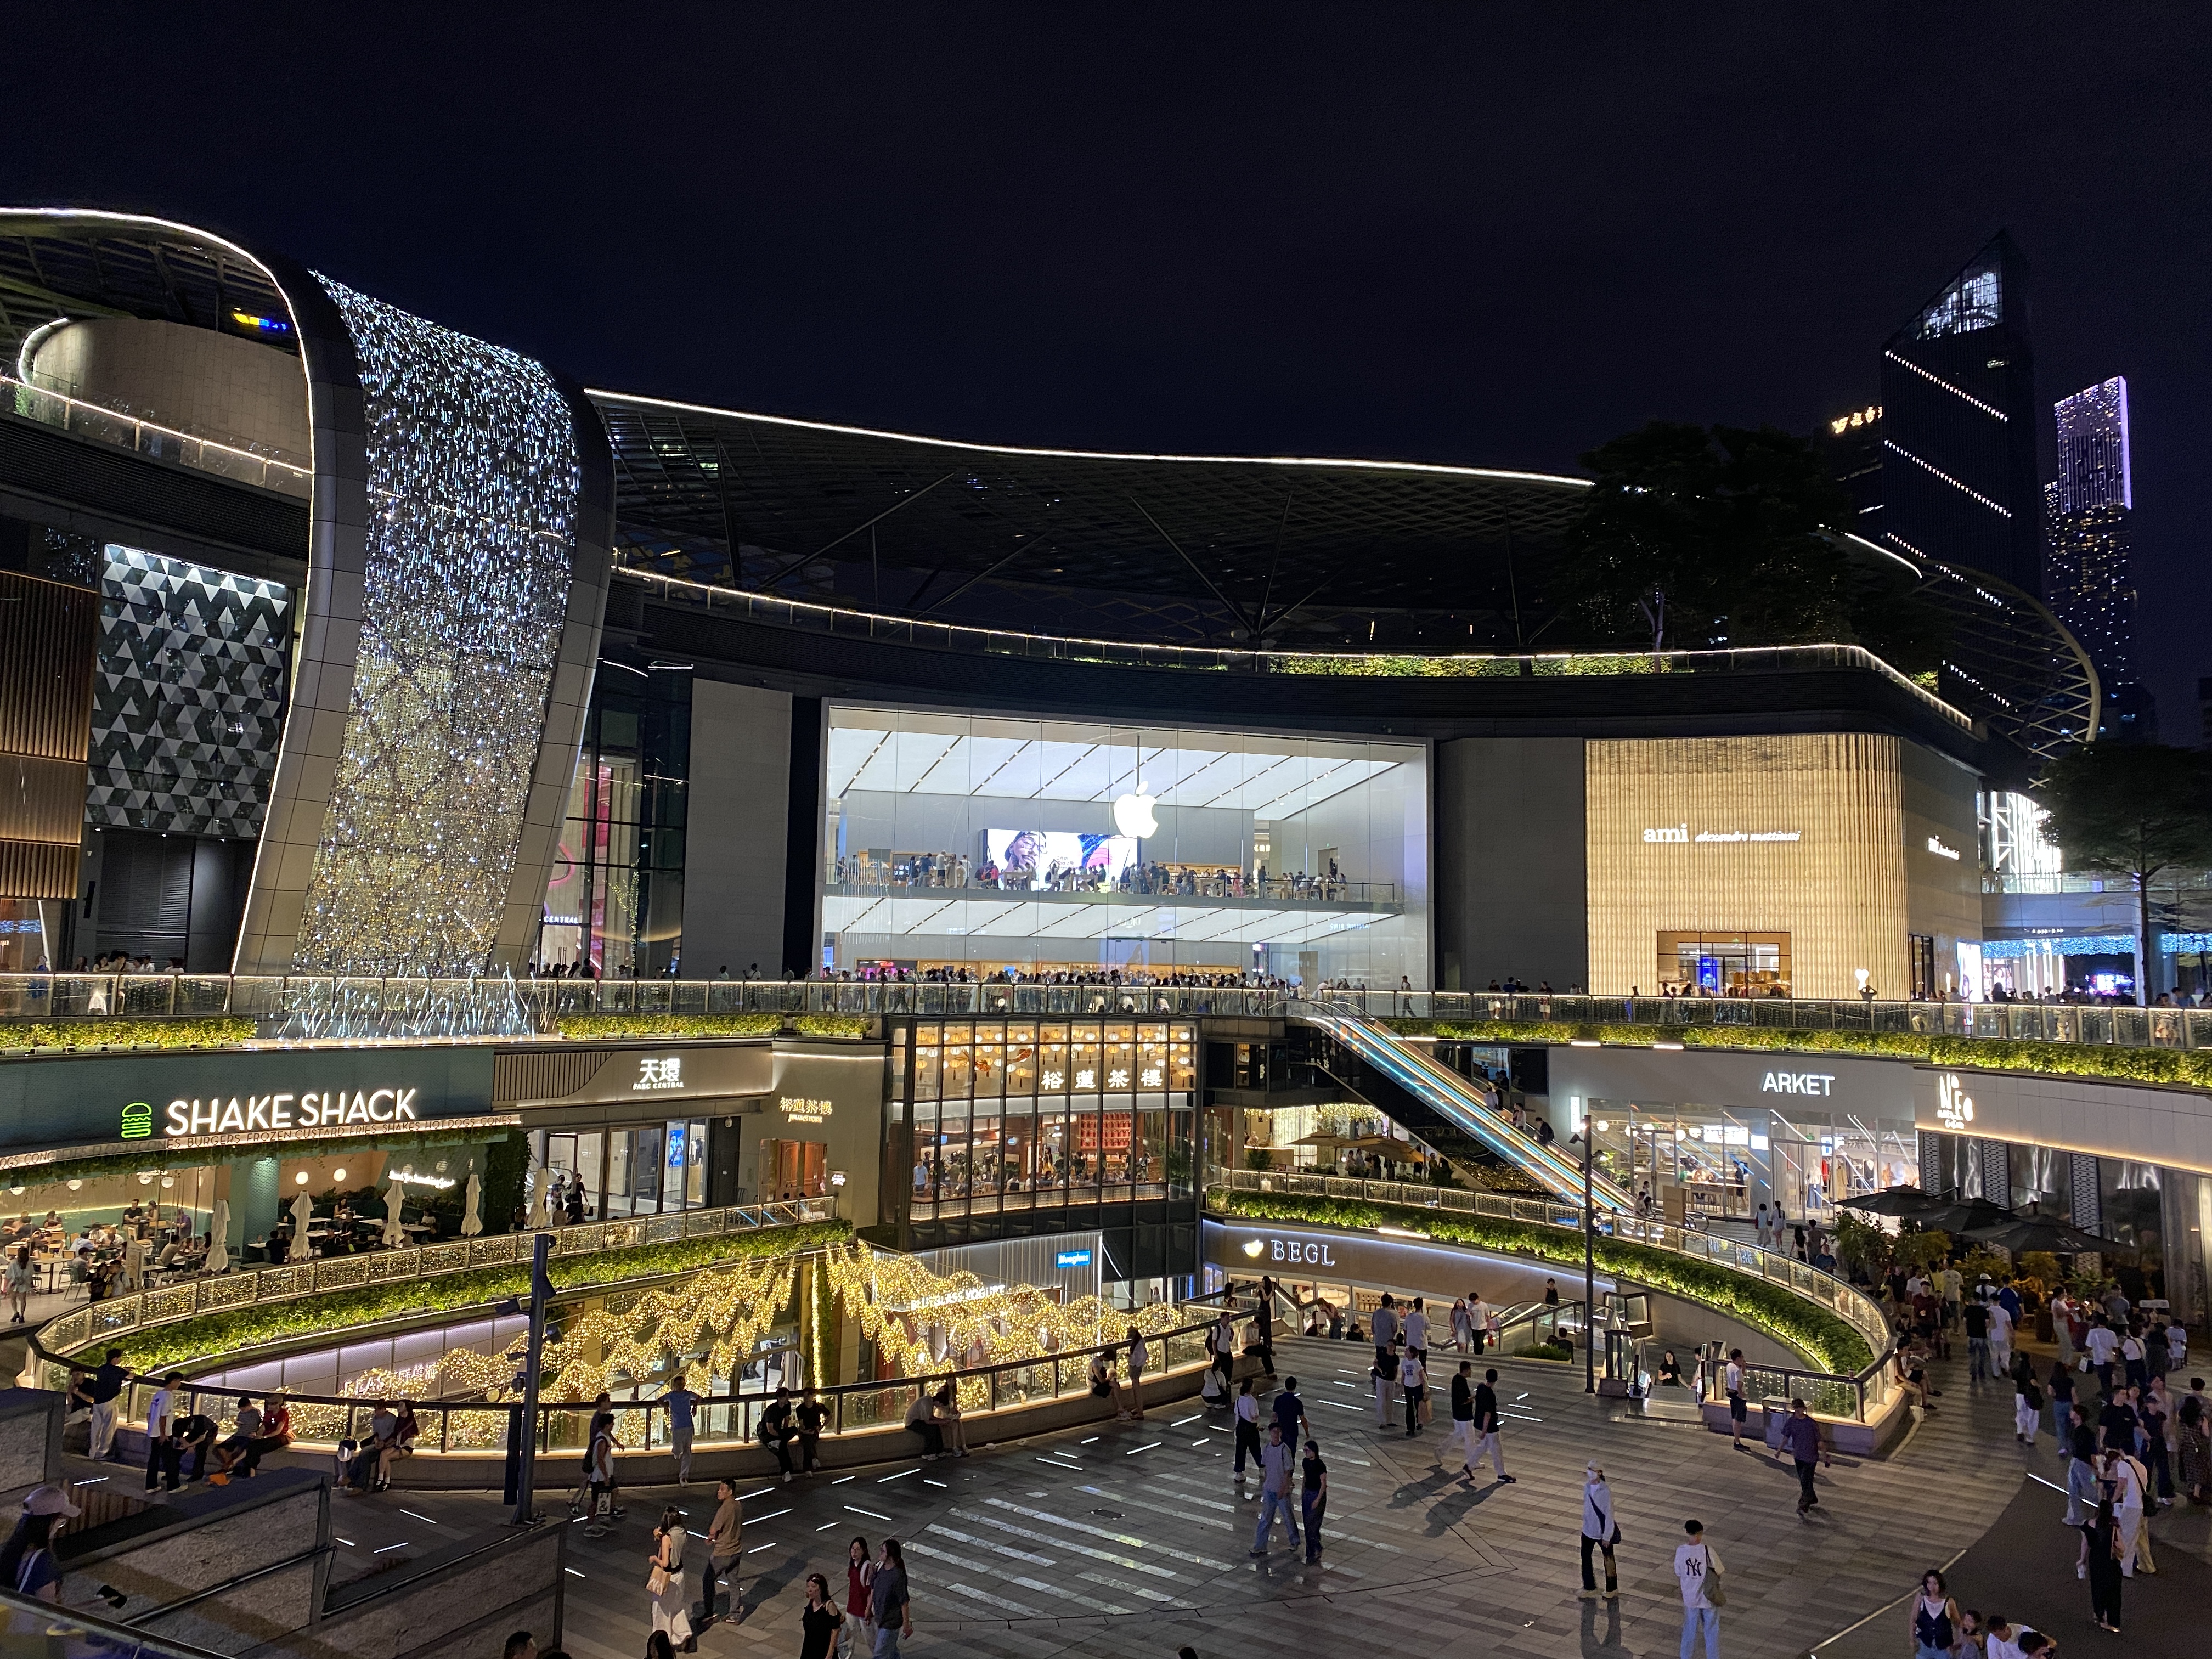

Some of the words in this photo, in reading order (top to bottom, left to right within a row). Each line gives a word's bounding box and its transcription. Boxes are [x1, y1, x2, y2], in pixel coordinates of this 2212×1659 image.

[1644, 823, 1689, 842] ami
[640, 1058, 680, 1084] 天環
[653, 1081, 684, 1089] CENTRAL
[1762, 1072, 1836, 1096] ARKET
[165, 1095, 294, 1136] SHAKE
[298, 1088, 416, 1127] SHACK
[187, 1134, 240, 1148] BURGERS
[247, 1129, 292, 1143] FROZEN
[295, 1126, 345, 1139] CUSTARD
[349, 1124, 377, 1135] FRIES
[382, 1121, 420, 1133] SHAKES
[425, 1119, 447, 1131] HOT
[448, 1118, 475, 1128] DOGS
[480, 1115, 512, 1126] CONES
[1271, 1239, 1335, 1266] BEGL
[1685, 1558, 1701, 1577] NY
